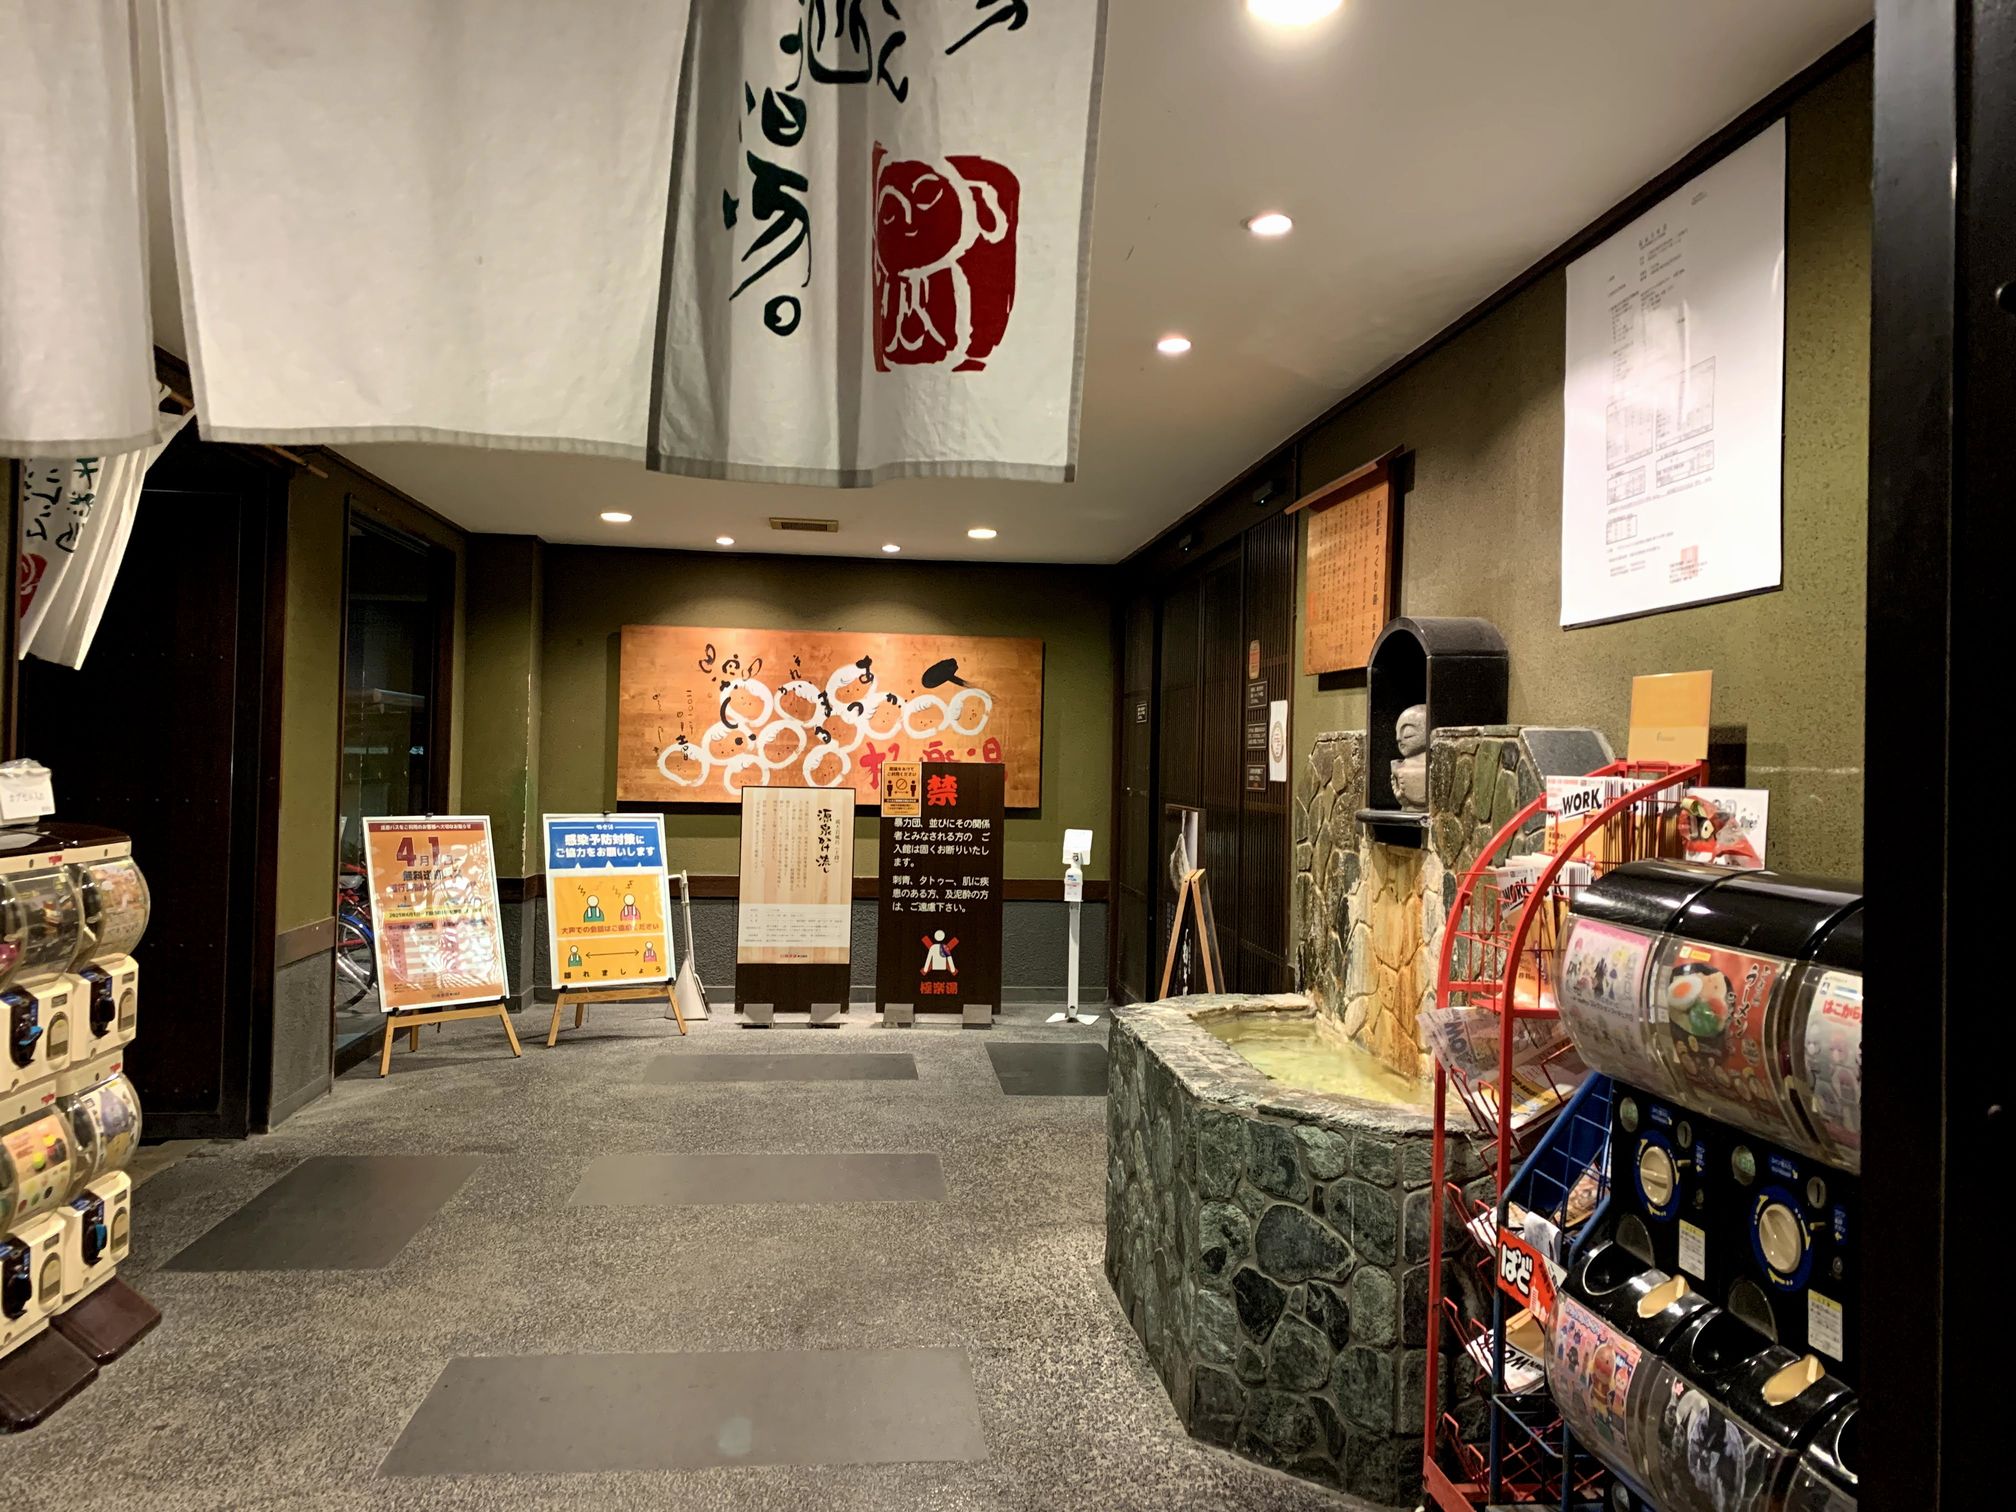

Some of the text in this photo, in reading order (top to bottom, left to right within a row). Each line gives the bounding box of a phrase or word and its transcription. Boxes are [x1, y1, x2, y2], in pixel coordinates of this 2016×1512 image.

[927, 774, 958, 807] 禁
[1562, 788, 1602, 815] WORK
[894, 817, 991, 829] 暴力団、並びにその関係
[564, 833, 645, 846] 感染予防対策に
[815, 808, 832, 874] 源泉かけ流し
[893, 831, 973, 842] 者とみなされる方の
[555, 846, 656, 859] ご協力をお願いします
[893, 844, 990, 856] 入館は固くお断りいたし
[893, 857, 915, 868] ます。
[892, 888, 989, 900] 患のある方、及泥酔の方
[892, 902, 966, 913] は、ご遠慮下さい。
[920, 981, 958, 995] 極楽湯
[1501, 1243, 1534, 1296] ぱど
